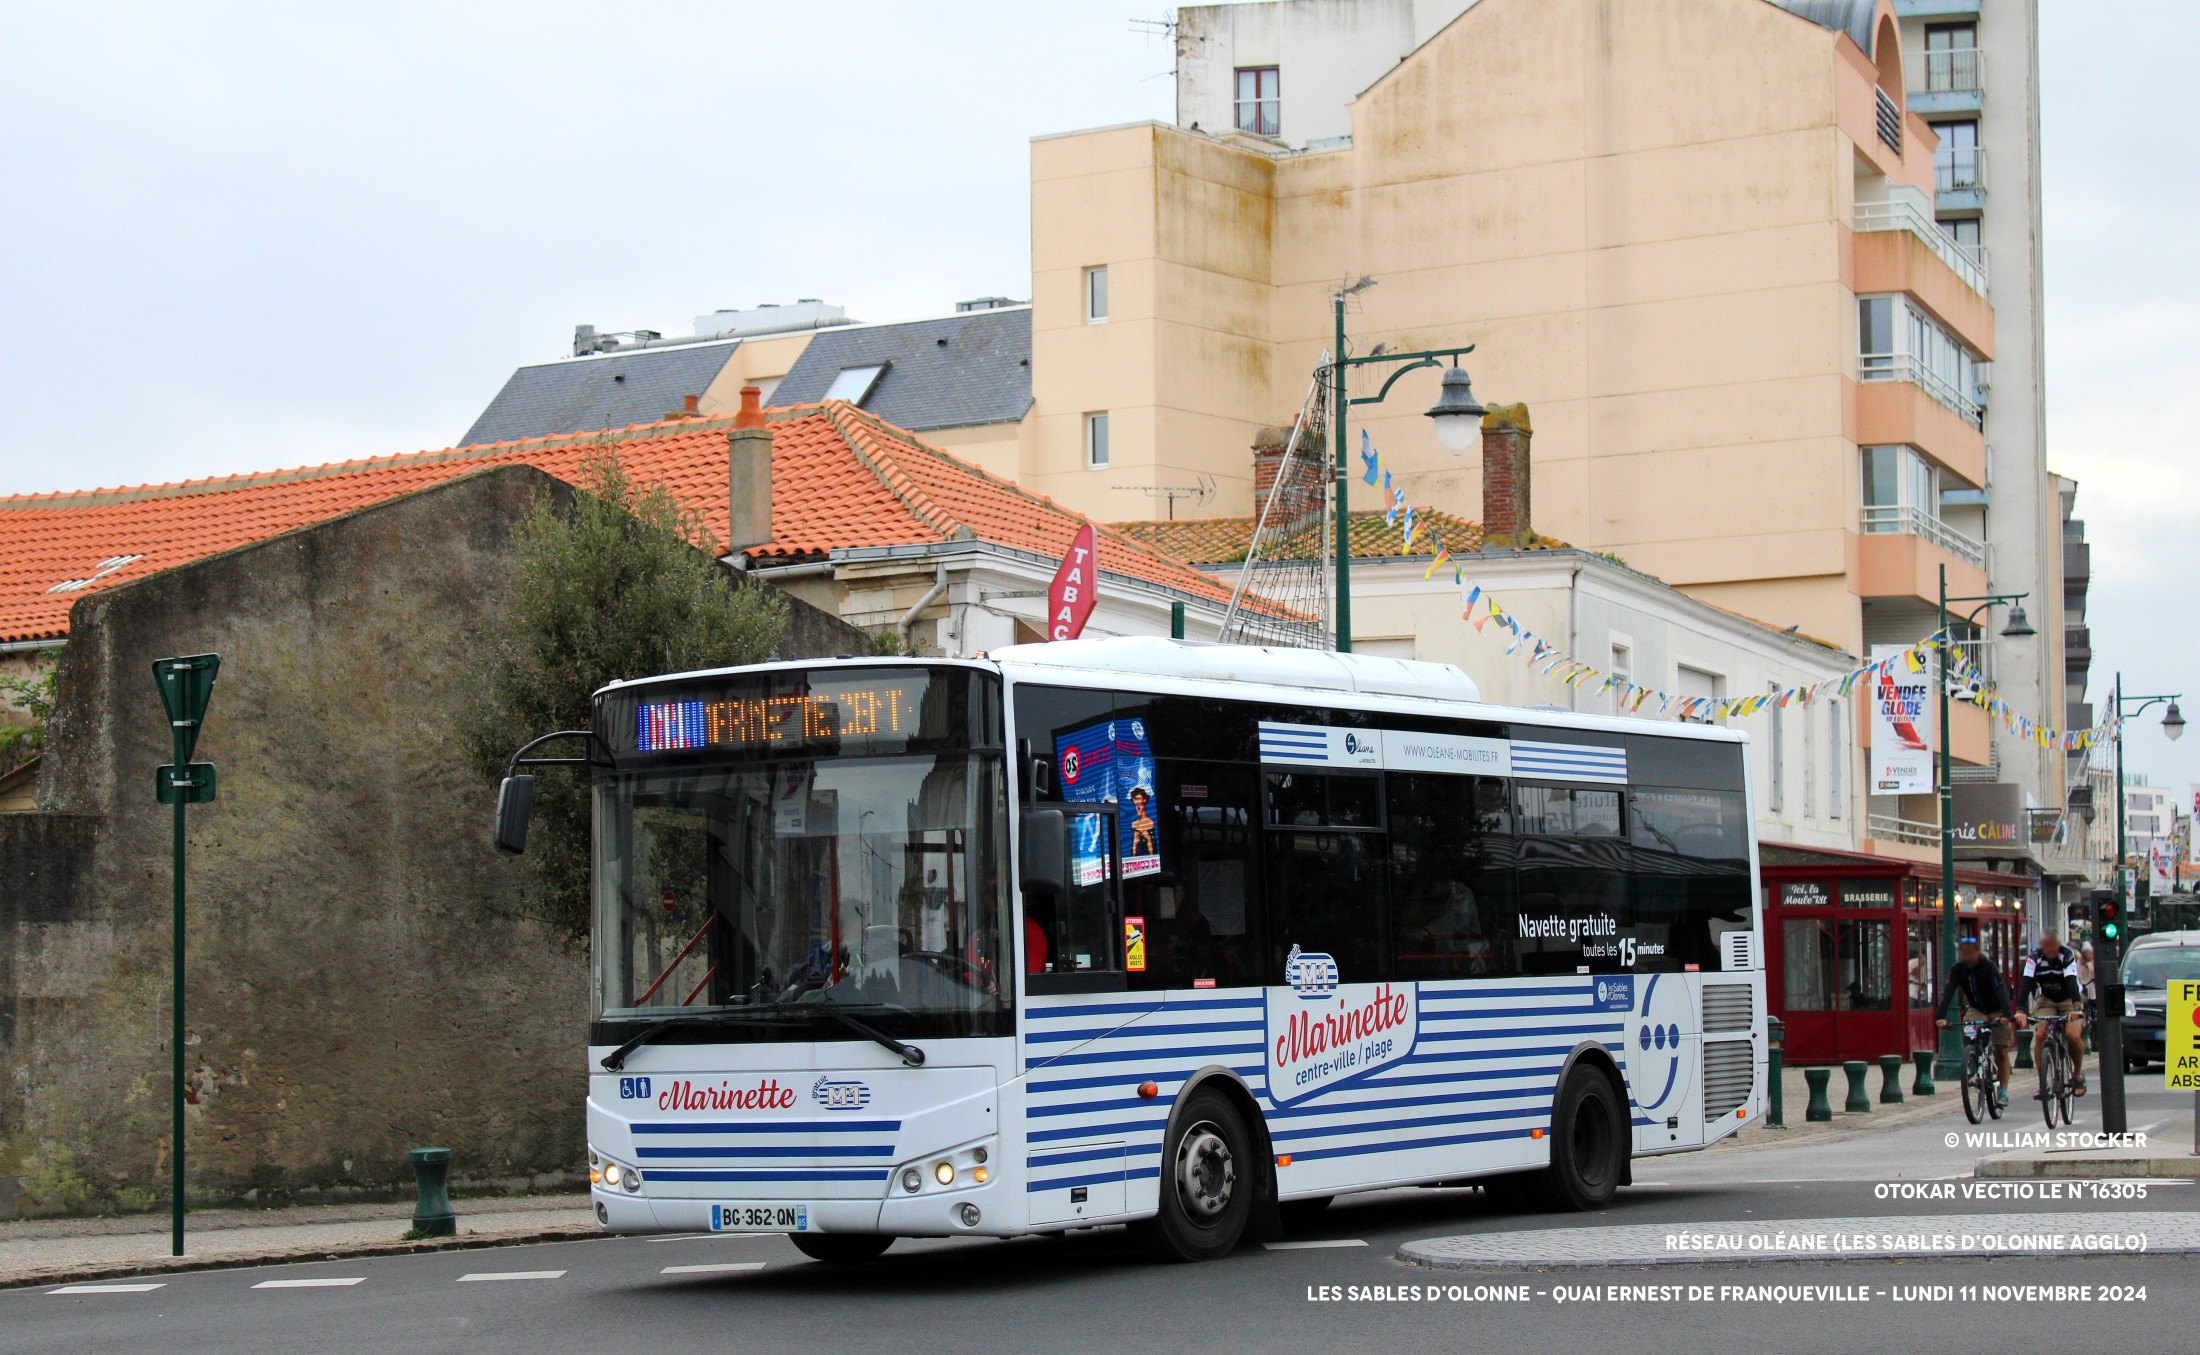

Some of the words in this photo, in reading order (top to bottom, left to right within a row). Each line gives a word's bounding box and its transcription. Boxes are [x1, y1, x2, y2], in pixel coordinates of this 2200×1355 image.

[1053, 547, 1088, 640] TABAC
[1877, 685, 1927, 700] VENDÉE
[1881, 701, 1922, 715] GLOBE
[1403, 744, 1499, 763] WWW.OLEANE-MOBILITES.FR
[1978, 820, 2016, 840] CÂLINE
[1809, 884, 1819, 894] la
[1844, 893, 1888, 902] BRASSERIE
[1518, 913, 1566, 938] Navette
[1569, 912, 1616, 943] gratuite
[1583, 943, 1605, 957] toutes
[1606, 942, 1617, 957] les
[1618, 937, 1637, 967] 15
[1637, 942, 1665, 955] minutes
[1299, 962, 1329, 993] M1
[1613, 982, 1628, 992] Sables
[1276, 982, 1409, 1068] Marinette
[1295, 1049, 1356, 1086] centre-ville
[1358, 1042, 1363, 1065] /
[1365, 1038, 1393, 1064] plage
[659, 1079, 797, 1110] Marinette
[811, 1075, 828, 1099] gratuit
[827, 1086, 860, 1106] M1
[798, 1218, 806, 1227] 85
